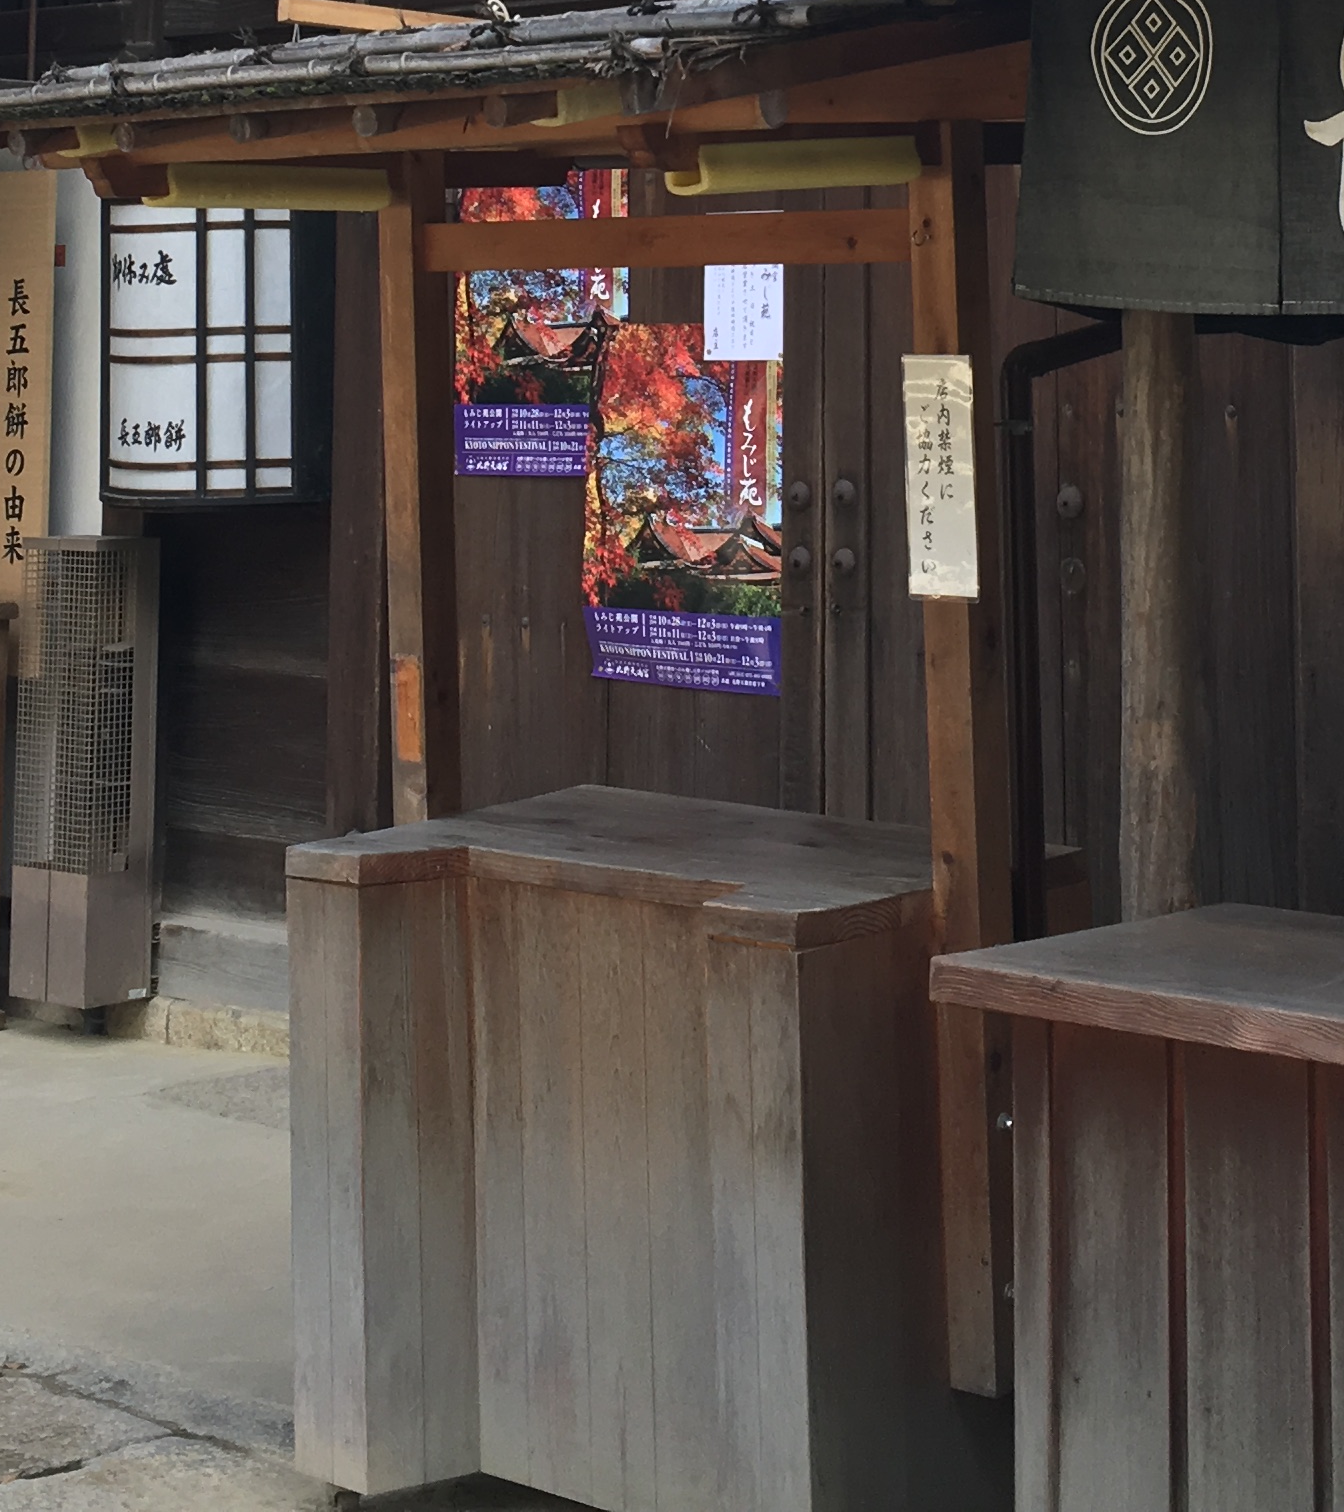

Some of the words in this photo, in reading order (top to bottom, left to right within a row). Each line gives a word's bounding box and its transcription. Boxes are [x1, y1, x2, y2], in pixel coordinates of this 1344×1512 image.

[2, 278, 30, 565] 長五郎餅の由来
[117, 418, 186, 453] 長五郎餅
[464, 441, 487, 450] KYOTO
[487, 441, 514, 450] NIPPON
[515, 441, 548, 451] FESTIVAL
[739, 398, 763, 506] もみじ苑
[934, 378, 955, 500] 店内禁煙に
[916, 405, 937, 574] ご協力ください
[599, 644, 624, 655] KYOTO
[624, 646, 652, 658] NIPPON
[652, 649, 690, 661] FESTIVAL
